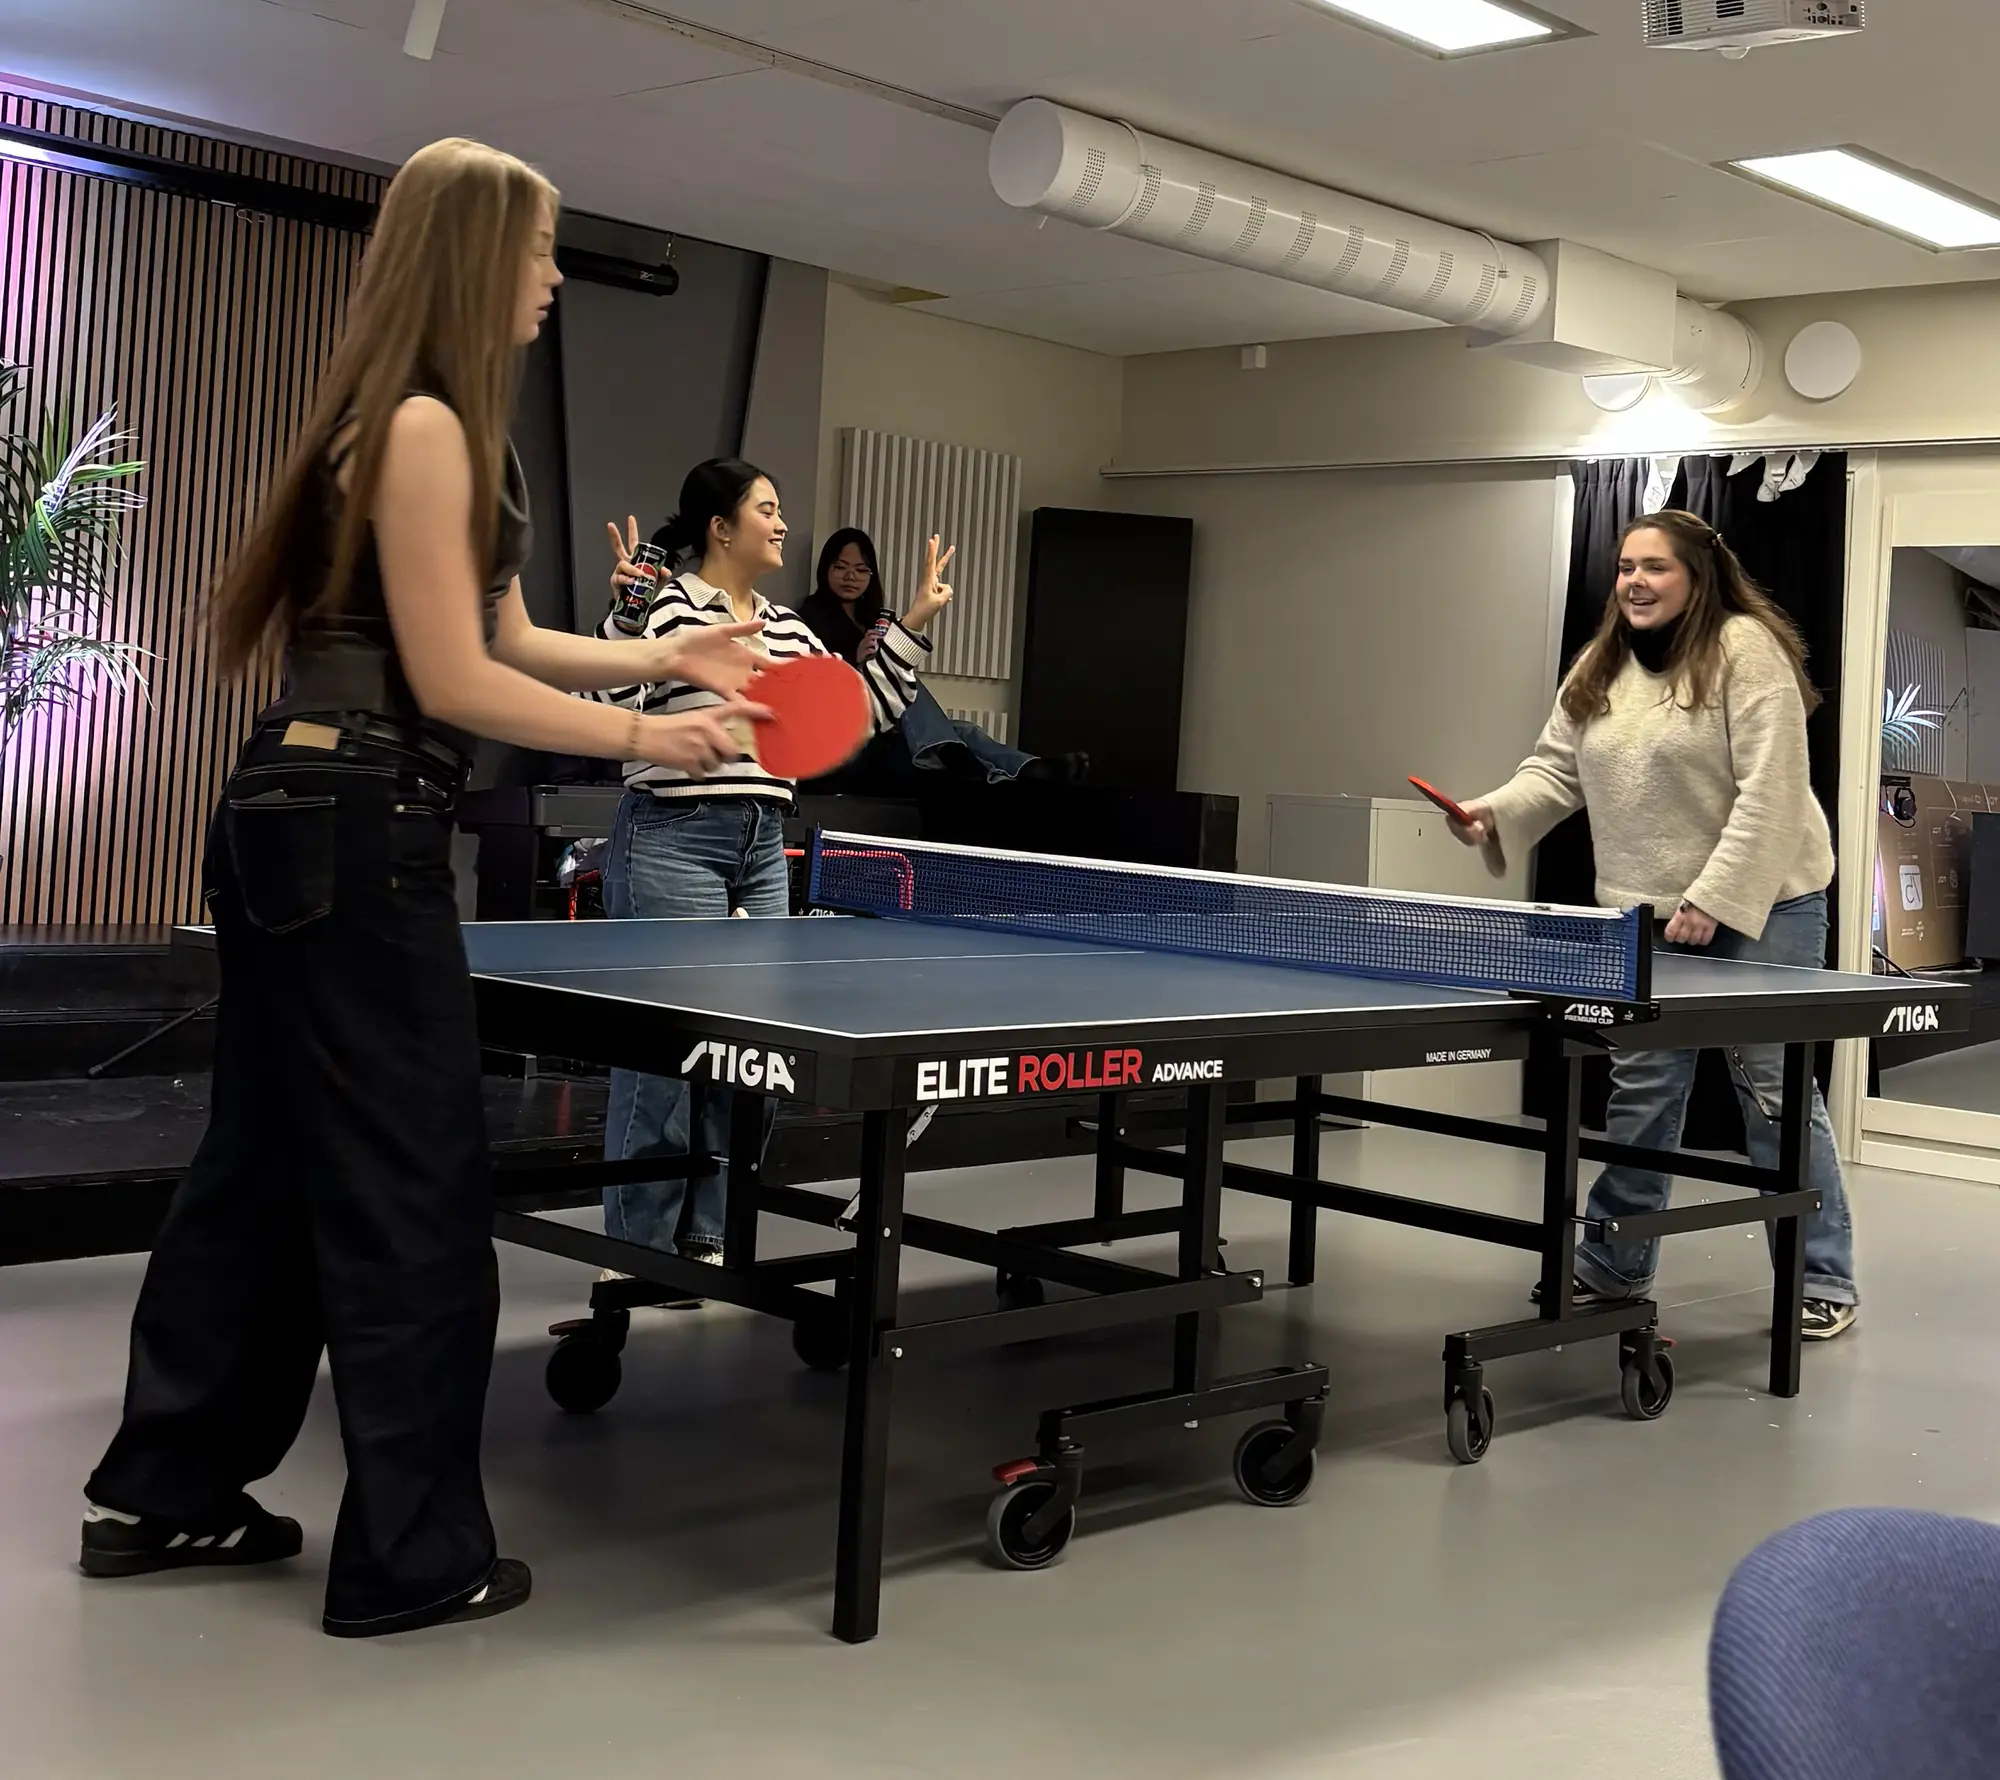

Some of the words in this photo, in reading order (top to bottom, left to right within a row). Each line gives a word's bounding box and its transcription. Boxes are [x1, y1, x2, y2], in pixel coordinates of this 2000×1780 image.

[1564, 1014, 1597, 1024] PREMIUM
[1598, 1017, 1614, 1025] CUP
[1426, 1051, 1447, 1063] MADE
[1447, 1050, 1456, 1062] IN
[1456, 1048, 1492, 1061] GERMANY
[916, 1057, 1009, 1101] ELITE
[1018, 1049, 1143, 1093] ROLLER
[1152, 1059, 1224, 1083] ADVANCE
